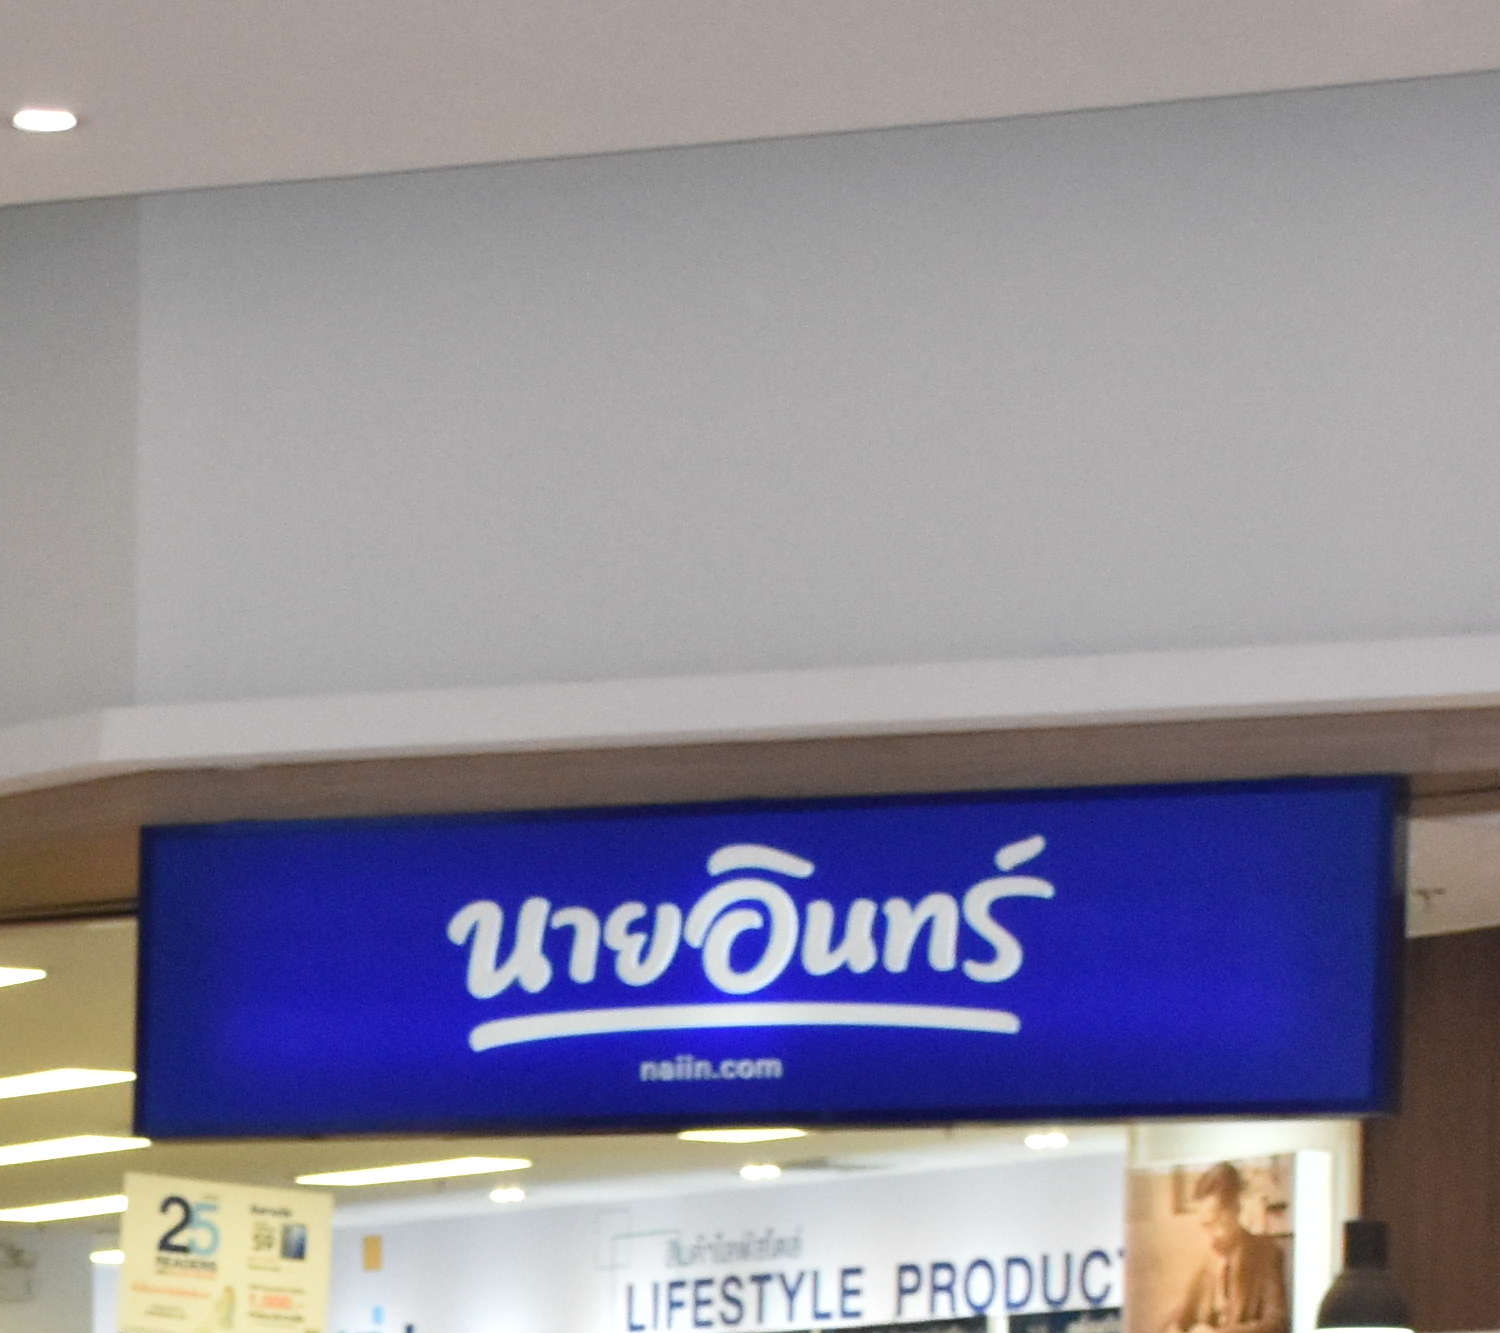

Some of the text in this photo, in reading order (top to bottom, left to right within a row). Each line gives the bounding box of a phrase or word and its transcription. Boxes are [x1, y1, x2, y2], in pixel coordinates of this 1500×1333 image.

[446, 834, 1056, 1001] นายอินทร์
[639, 1054, 784, 1082] naiin.com
[158, 1195, 220, 1256] 25
[626, 1247, 1125, 1332] LIFESTYLE PRODUC
